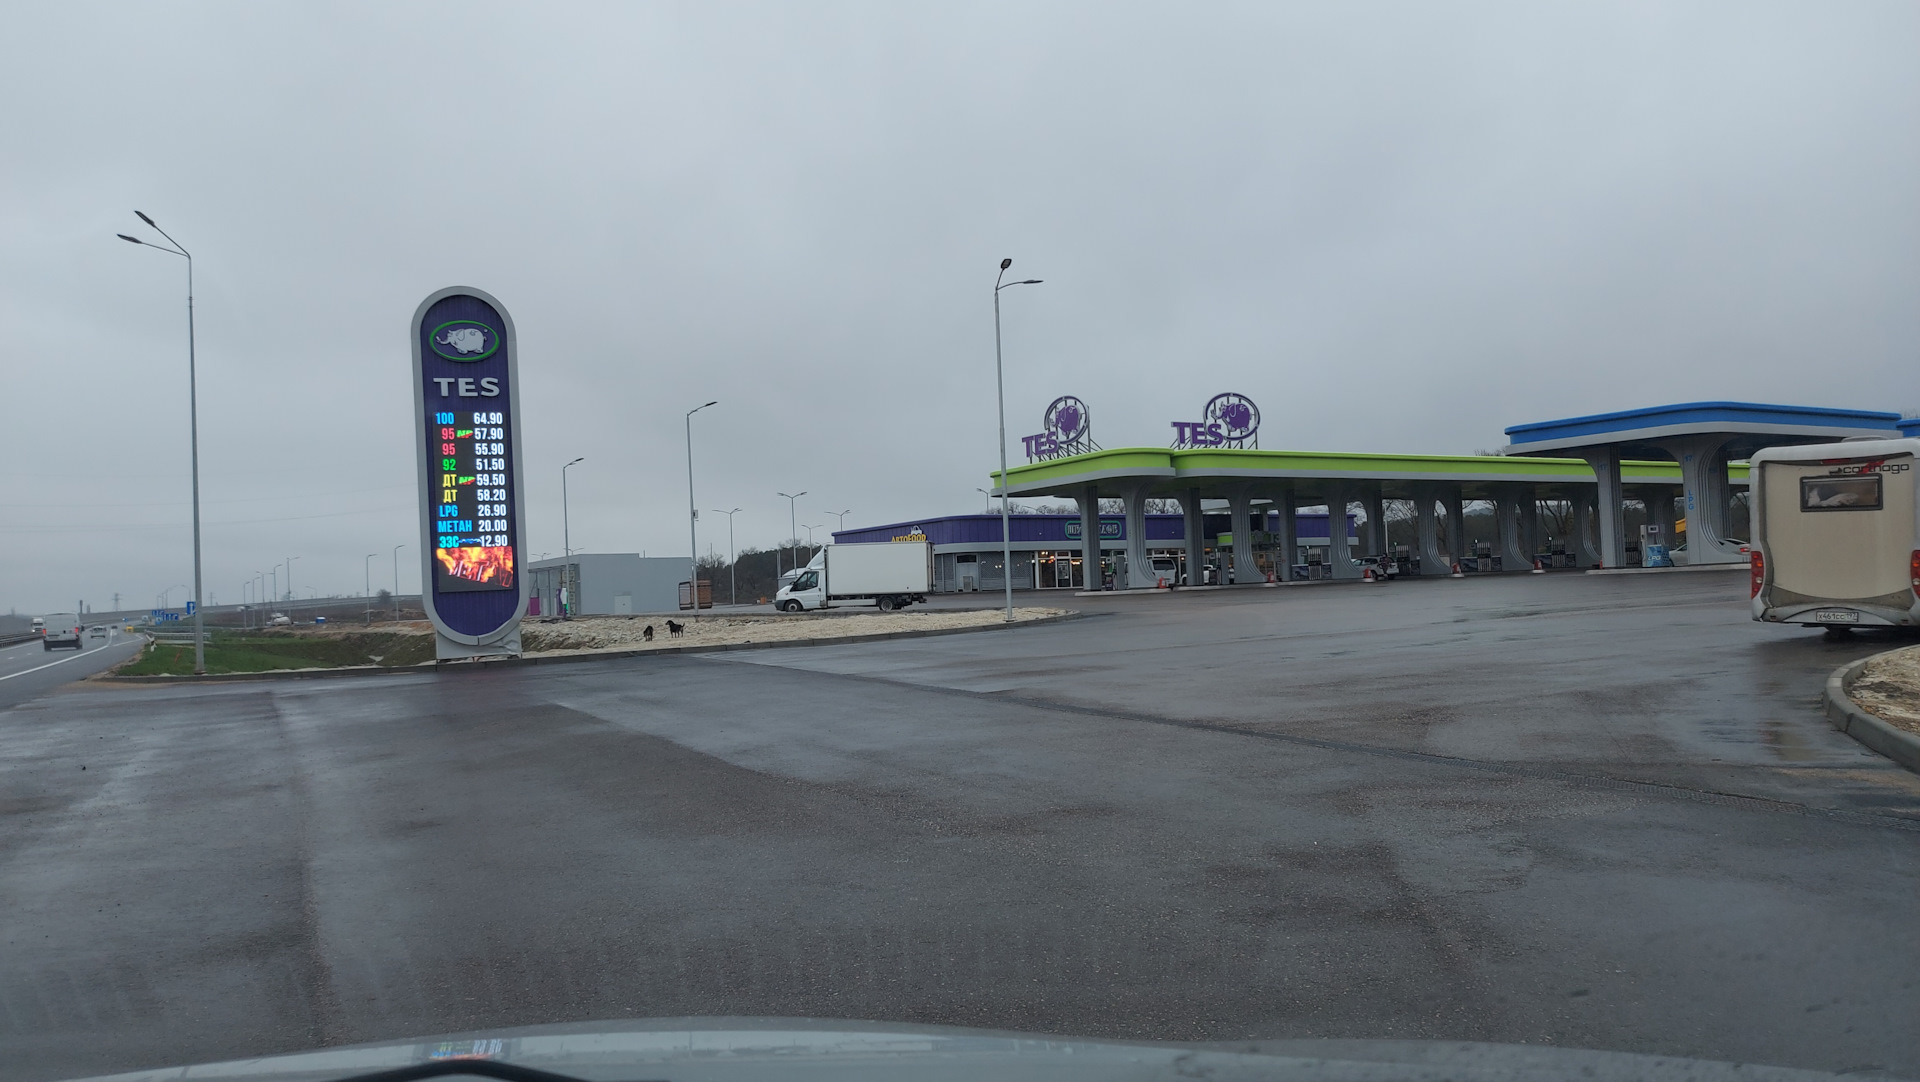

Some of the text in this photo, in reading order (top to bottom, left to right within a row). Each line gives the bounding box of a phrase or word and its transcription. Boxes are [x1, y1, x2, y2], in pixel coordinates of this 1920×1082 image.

[433, 377, 500, 397] TES
[435, 412, 503, 425] 100 64.90
[441, 427, 455, 440] 95
[474, 427, 504, 440] 57.90
[1171, 421, 1225, 446] TES
[442, 442, 505, 455] 95 55.90
[1021, 431, 1060, 458] TES
[442, 458, 505, 471] 92 51.50
[442, 474, 457, 488] ДТ
[476, 473, 506, 486] 59.50
[443, 488, 506, 503] ДТ 58.20
[1687, 490, 1695, 510] LPG
[439, 504, 507, 518] LPG 26.90
[437, 519, 508, 533] МЕТАН 20.00
[480, 534, 508, 547] 12.90
